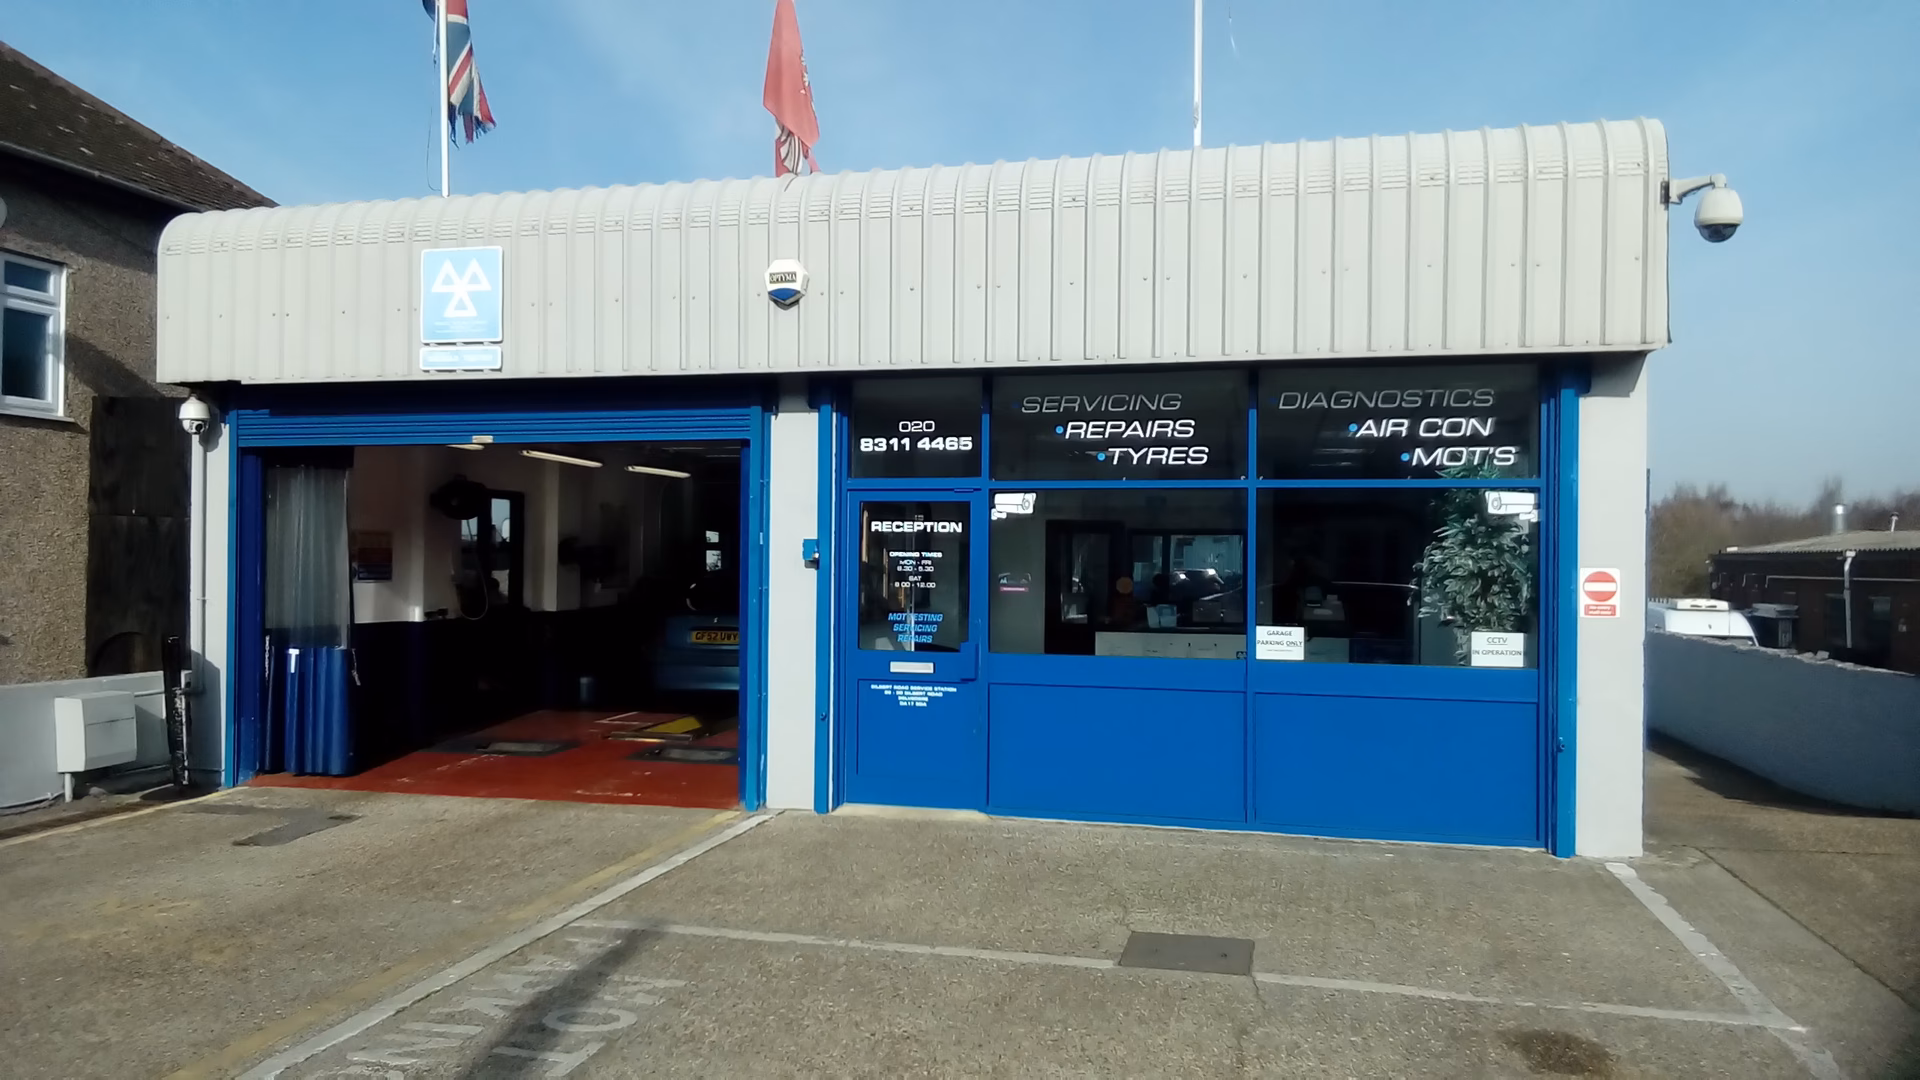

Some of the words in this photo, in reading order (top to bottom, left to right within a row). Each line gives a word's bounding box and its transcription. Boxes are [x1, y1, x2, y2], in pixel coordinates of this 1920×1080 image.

[1021, 393, 1182, 413] SERVICING
[1278, 389, 1495, 410] DIAGNOSTICS
[899, 421, 935, 432] 020
[1065, 419, 1196, 439] REPAIRS
[1355, 418, 1411, 438] AIR
[1419, 417, 1495, 437] CON
[860, 437, 910, 452] 8311
[917, 436, 973, 451] 4465
[1108, 446, 1210, 466] TYRES
[1411, 446, 1517, 467] MOT'S
[870, 521, 963, 533] RECEPTION
[888, 613, 907, 621] MOT
[908, 613, 943, 621] TESTING
[893, 623, 938, 632] SERVICING
[897, 634, 933, 643] REPAIRS
[1486, 636, 1508, 644] CCTV
